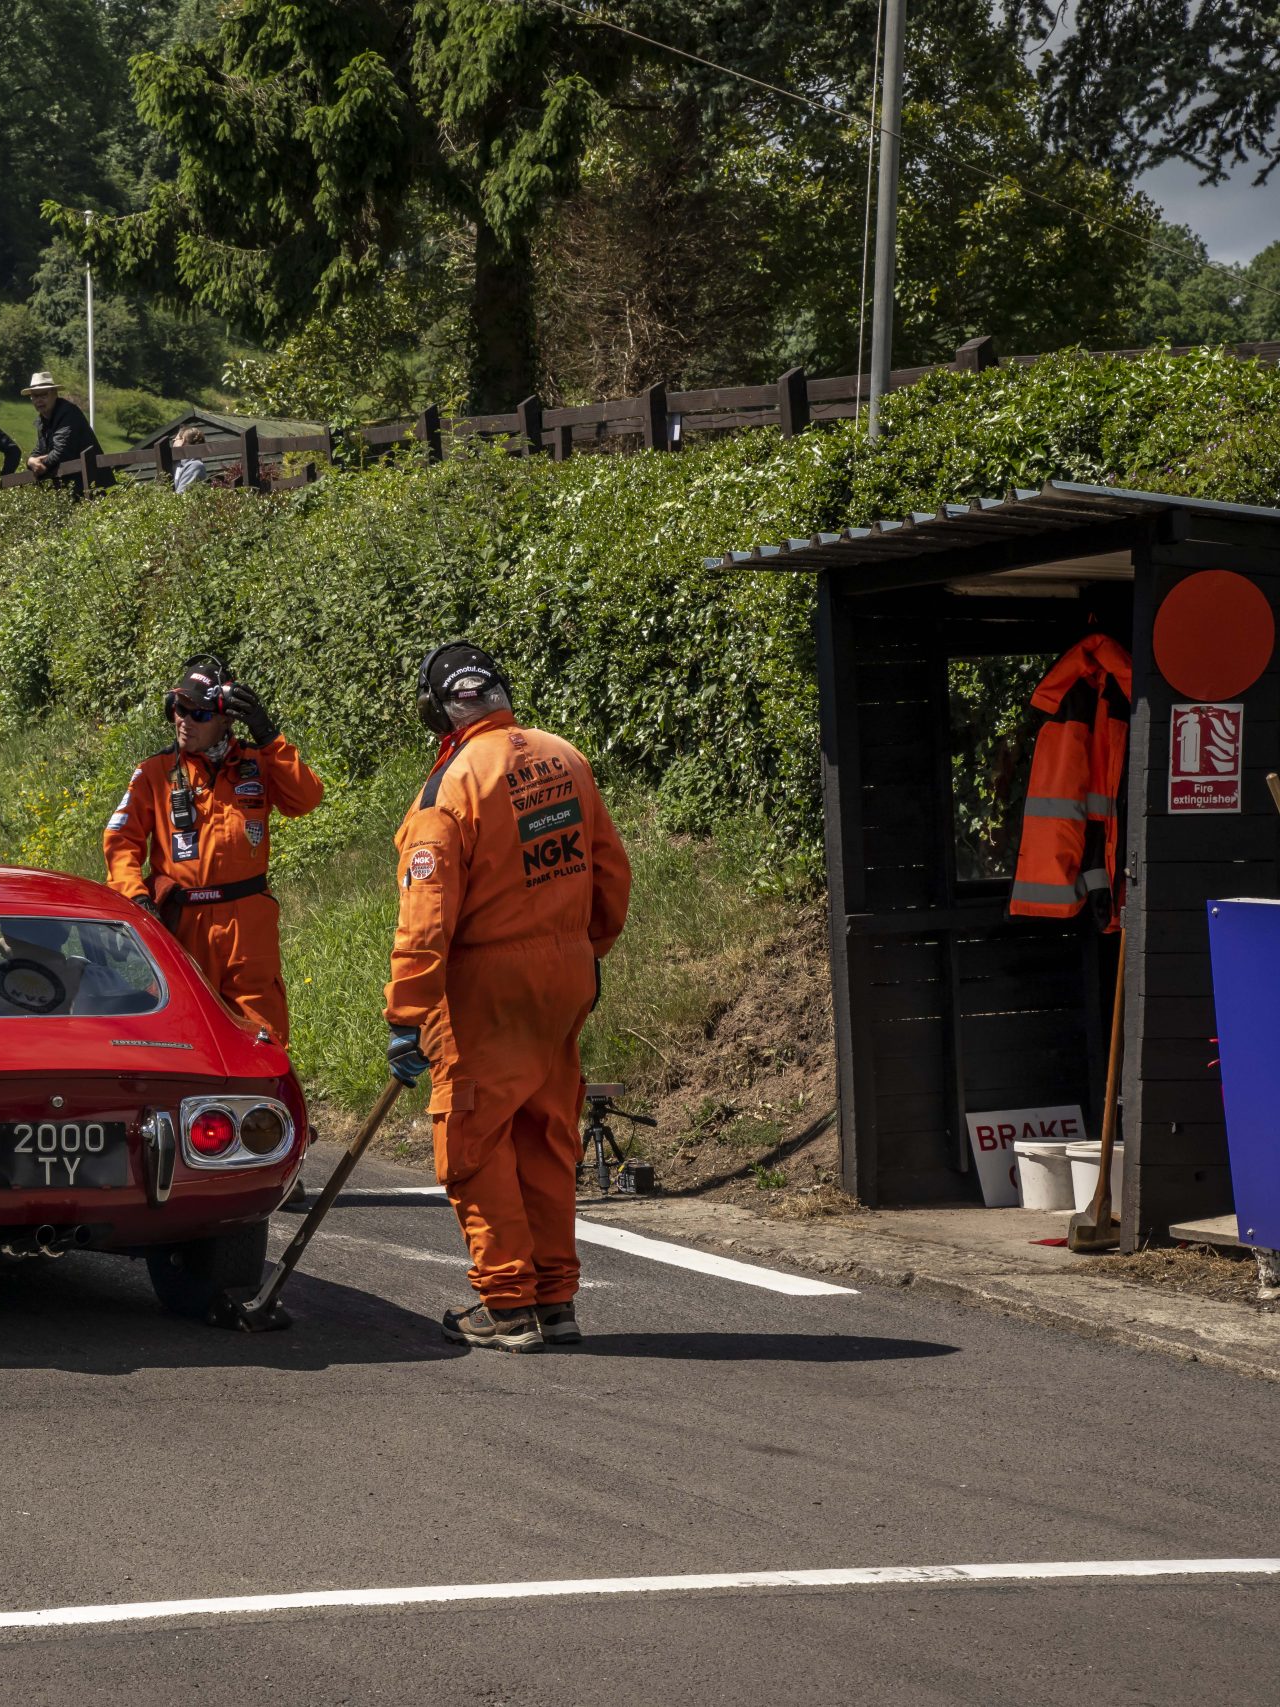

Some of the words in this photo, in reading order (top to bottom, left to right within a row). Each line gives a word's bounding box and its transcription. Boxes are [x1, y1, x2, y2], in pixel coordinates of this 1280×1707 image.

[442, 665, 492, 688] www.motul.com
[512, 780, 573, 811] GINETTA
[1194, 784, 1214, 793] Fire
[528, 810, 571, 831] POLYFLOR
[414, 856, 431, 864] NGK
[523, 830, 585, 876] NGK
[526, 872, 553, 888] SPARK
[554, 862, 587, 880] PLUGS
[190, 890, 222, 901] MOTUL
[14, 1124, 105, 1154] 2000
[38, 1157, 81, 1186] TY
